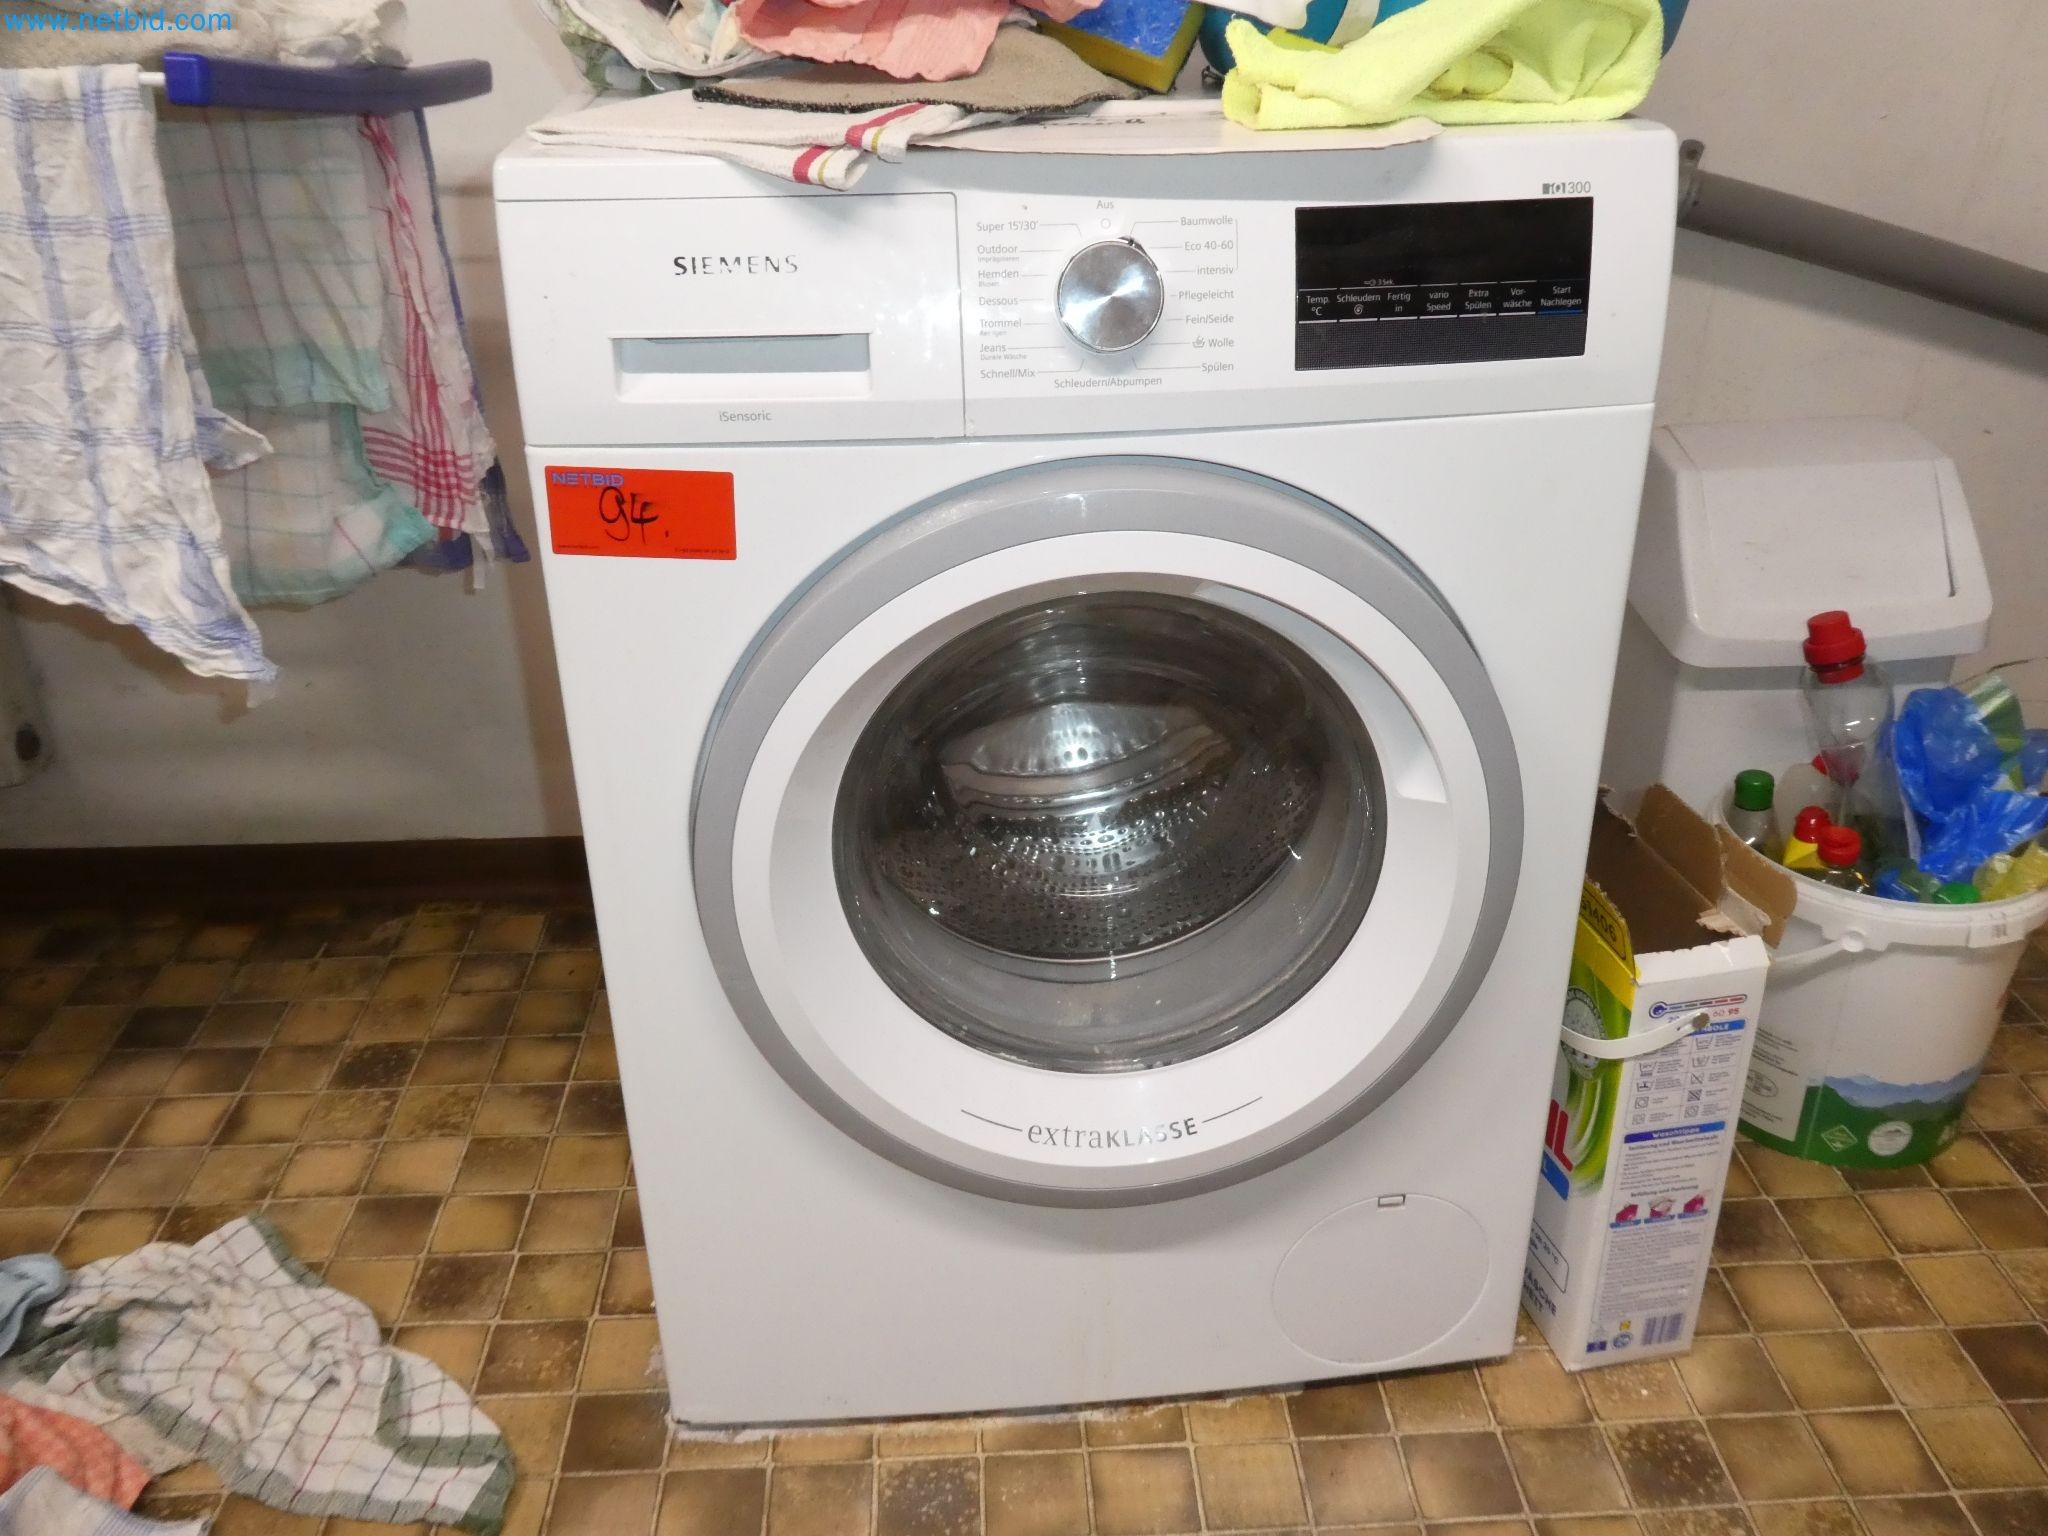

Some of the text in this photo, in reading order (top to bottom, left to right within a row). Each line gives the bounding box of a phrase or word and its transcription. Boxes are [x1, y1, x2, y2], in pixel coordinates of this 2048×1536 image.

[1096, 200, 1115, 209] Aus
[1180, 215, 1234, 226] Baumwolle
[976, 222, 1005, 233] Super
[977, 245, 1018, 254] Outdoor
[1184, 240, 1234, 251] Eco 40-60
[673, 255, 799, 275] SIEMENS
[978, 269, 1020, 279] Hemden
[1429, 290, 1450, 299] vario
[1468, 289, 1489, 298] Extra
[1510, 287, 1527, 296] Vor-
[1552, 285, 1572, 294] Start
[1178, 289, 1235, 302] Pflegeleicht
[1337, 293, 1381, 303] Schleudern
[1387, 292, 1411, 303] Fertig
[979, 296, 1019, 306] Dessous
[1465, 301, 1492, 311] Spülen
[1503, 299, 1533, 308] wäsche
[1541, 297, 1582, 307] Nachlegen
[1395, 304, 1403, 312] in
[1426, 302, 1452, 313] Speed
[980, 318, 1022, 328] Trommel
[1185, 314, 1235, 325] Fein/Seide
[1208, 337, 1236, 348] Wolle
[979, 344, 1007, 353] Jeans
[980, 367, 1036, 379] Schnell/Mix
[1201, 362, 1235, 374] Spülen
[1054, 377, 1163, 389] Schleudern/Abpumpen
[719, 410, 773, 422] iSensoric
[552, 472, 625, 487] NETBID
[1027, 1117, 1199, 1149] extraKLASSE
